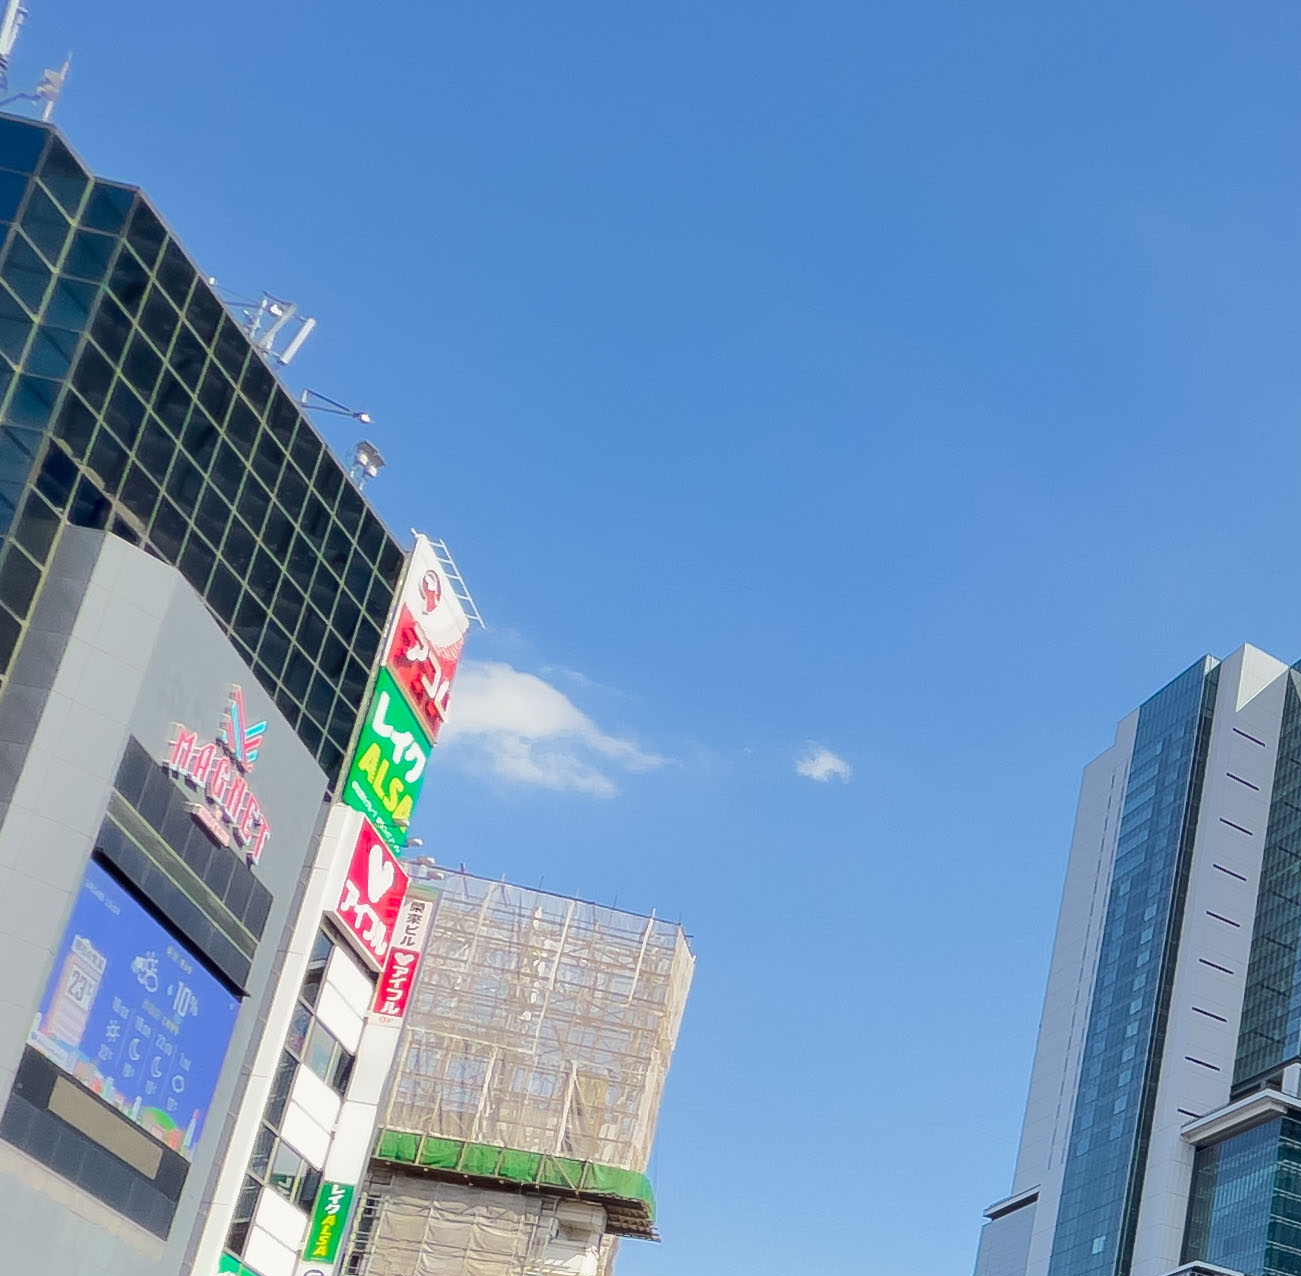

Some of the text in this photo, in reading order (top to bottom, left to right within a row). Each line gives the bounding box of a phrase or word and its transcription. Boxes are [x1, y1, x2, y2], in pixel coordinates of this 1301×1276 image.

[371, 690, 427, 783] レイク
[169, 727, 271, 865] MAGNET
[358, 742, 413, 834] ALSA
[340, 879, 388, 956] アイフル
[380, 965, 410, 1015] アイフル
